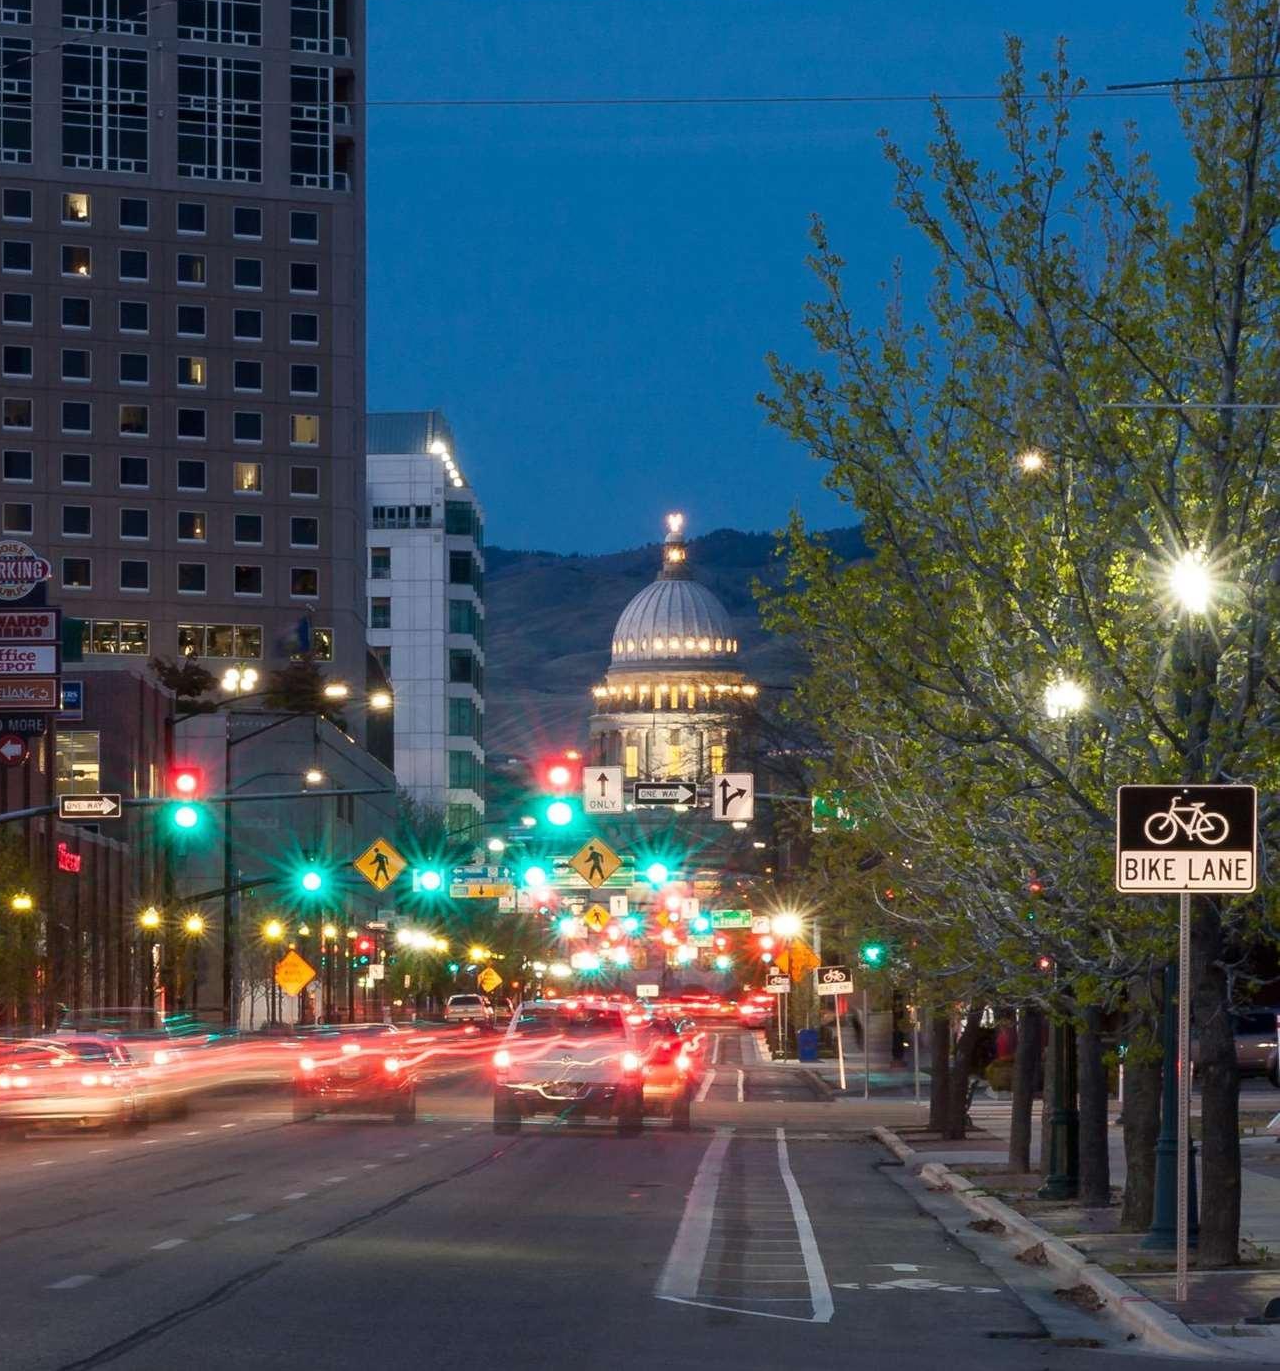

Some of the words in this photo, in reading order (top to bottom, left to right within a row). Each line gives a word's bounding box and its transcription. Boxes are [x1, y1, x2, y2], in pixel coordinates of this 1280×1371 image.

[8, 719, 44, 731] MORE
[640, 790, 658, 798] ONE
[661, 790, 679, 798] WAY
[87, 801, 103, 809] WAY
[590, 800, 617, 809] ONLY
[1125, 858, 1176, 881] BIKE
[1189, 858, 1247, 881] LANE
